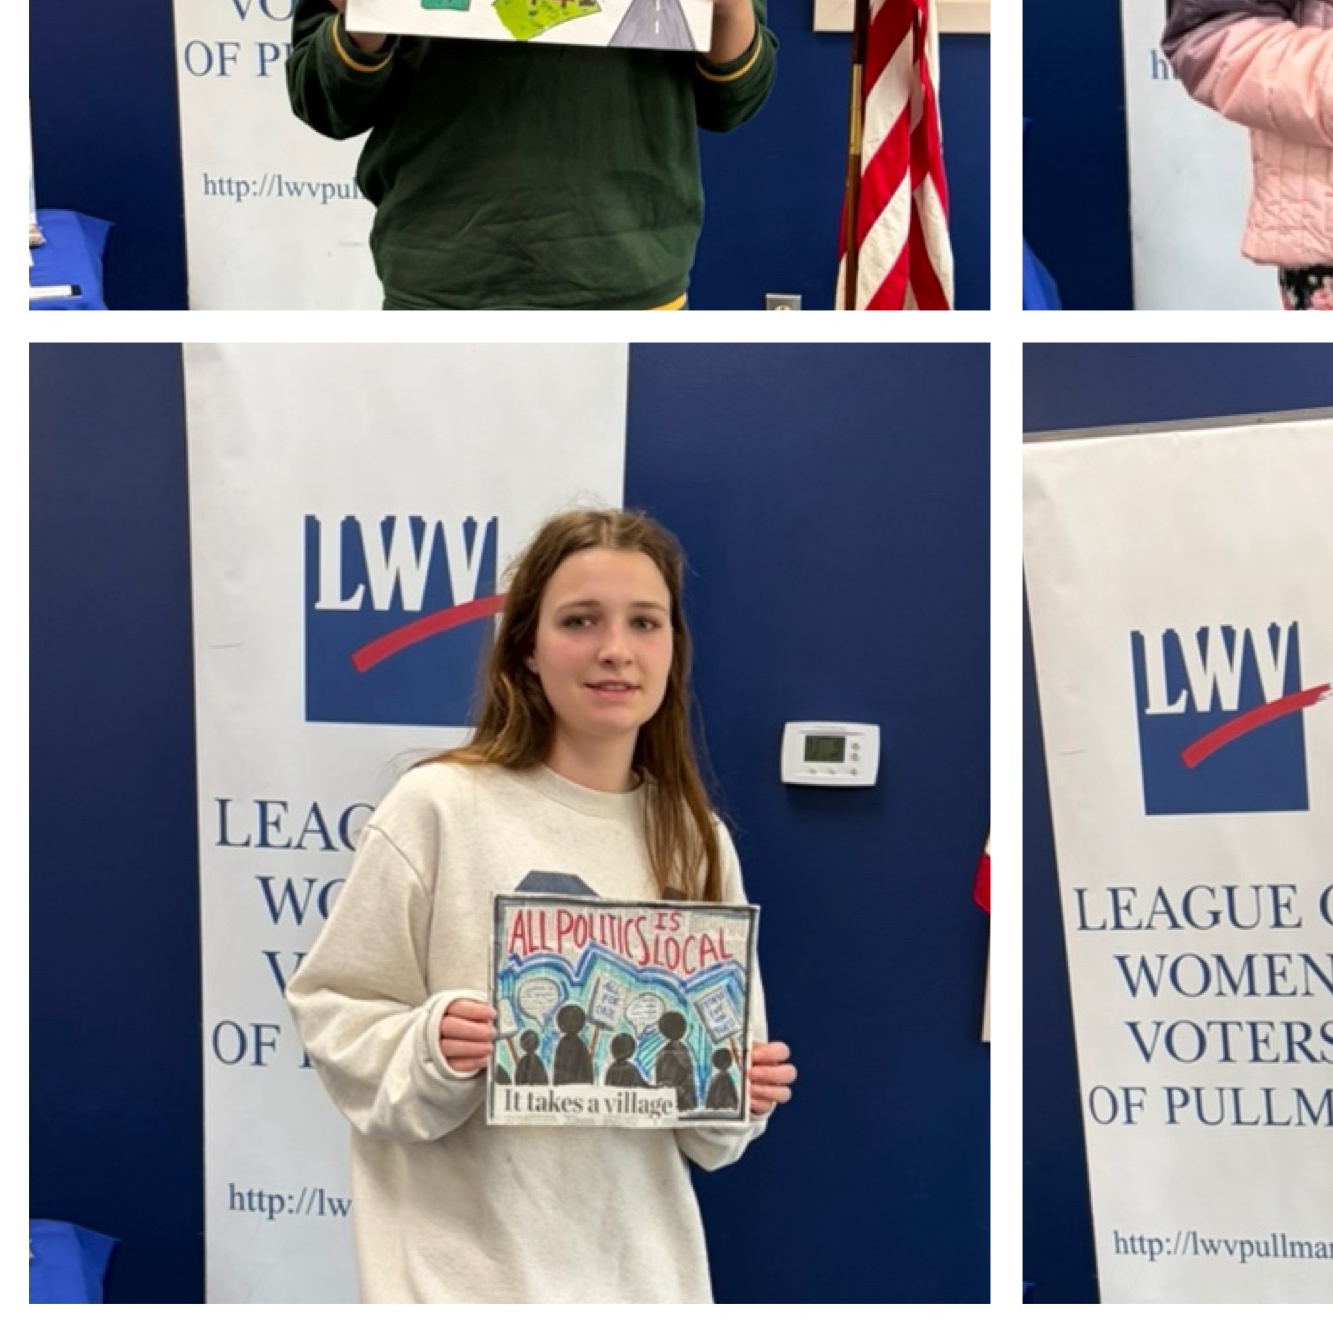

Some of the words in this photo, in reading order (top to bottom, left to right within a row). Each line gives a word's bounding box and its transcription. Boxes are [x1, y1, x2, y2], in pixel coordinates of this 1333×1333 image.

[185, 41, 239, 76] OF
[307, 515, 495, 612] LWV
[1134, 621, 1297, 715] LWV
[655, 912, 680, 932] IS
[1075, 885, 1301, 930] LEAGUE
[508, 909, 552, 955] ALL
[555, 909, 652, 966] POLITICS
[653, 927, 734, 975] LOCAL
[213, 1021, 280, 1066] OF
[505, 1088, 523, 1113] It
[527, 1089, 582, 1113] takes
[587, 1096, 600, 1113] a
[604, 1092, 674, 1118] village
[1089, 1086, 1146, 1124] OF
